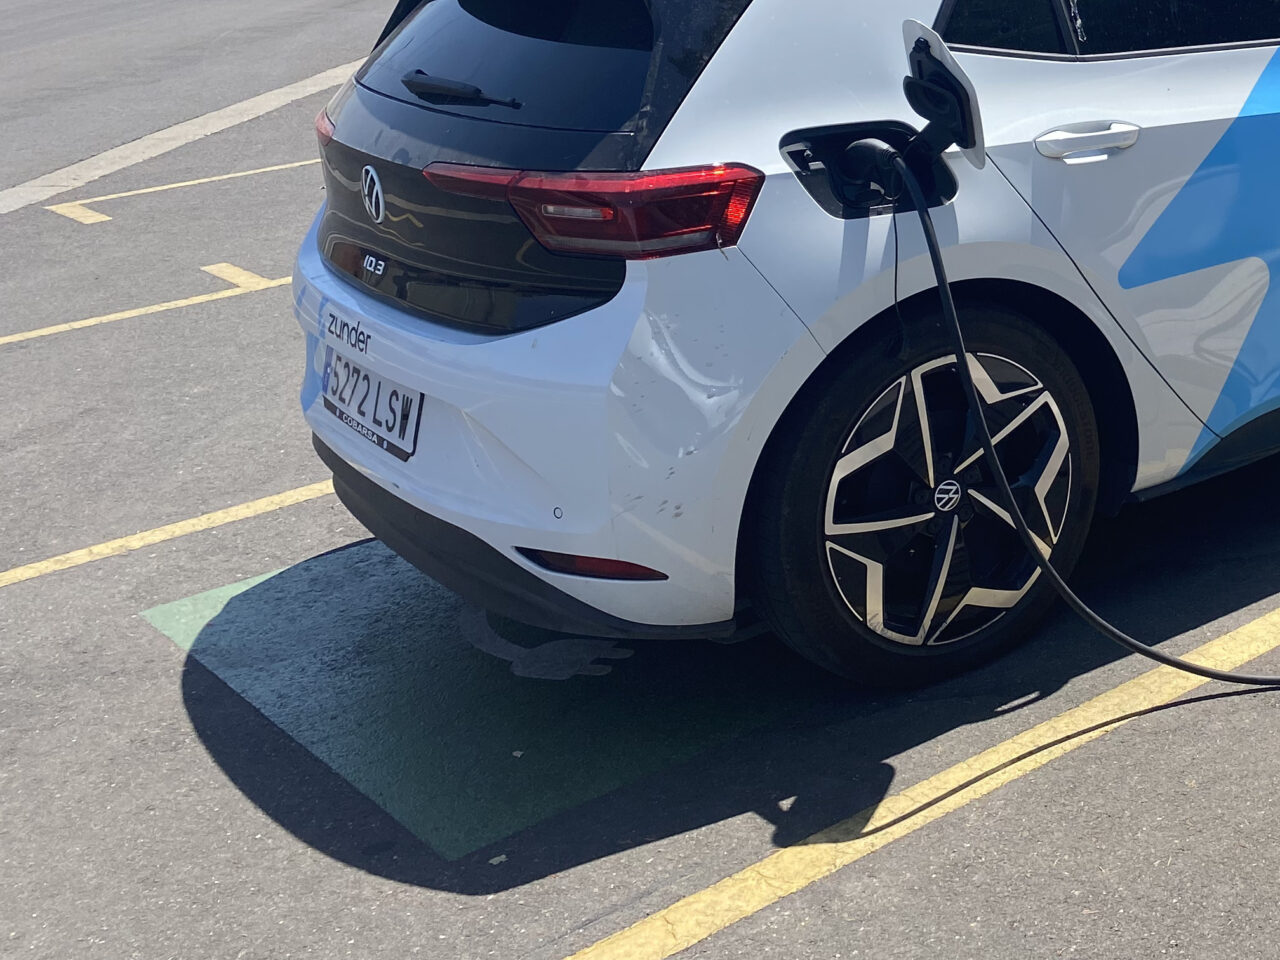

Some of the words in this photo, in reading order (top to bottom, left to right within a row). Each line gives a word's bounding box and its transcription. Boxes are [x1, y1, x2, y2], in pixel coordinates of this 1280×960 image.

[327, 312, 372, 355] zunder
[330, 356, 371, 419] 5272
[371, 380, 414, 442] LSW
[342, 413, 378, 445] COBARSA
